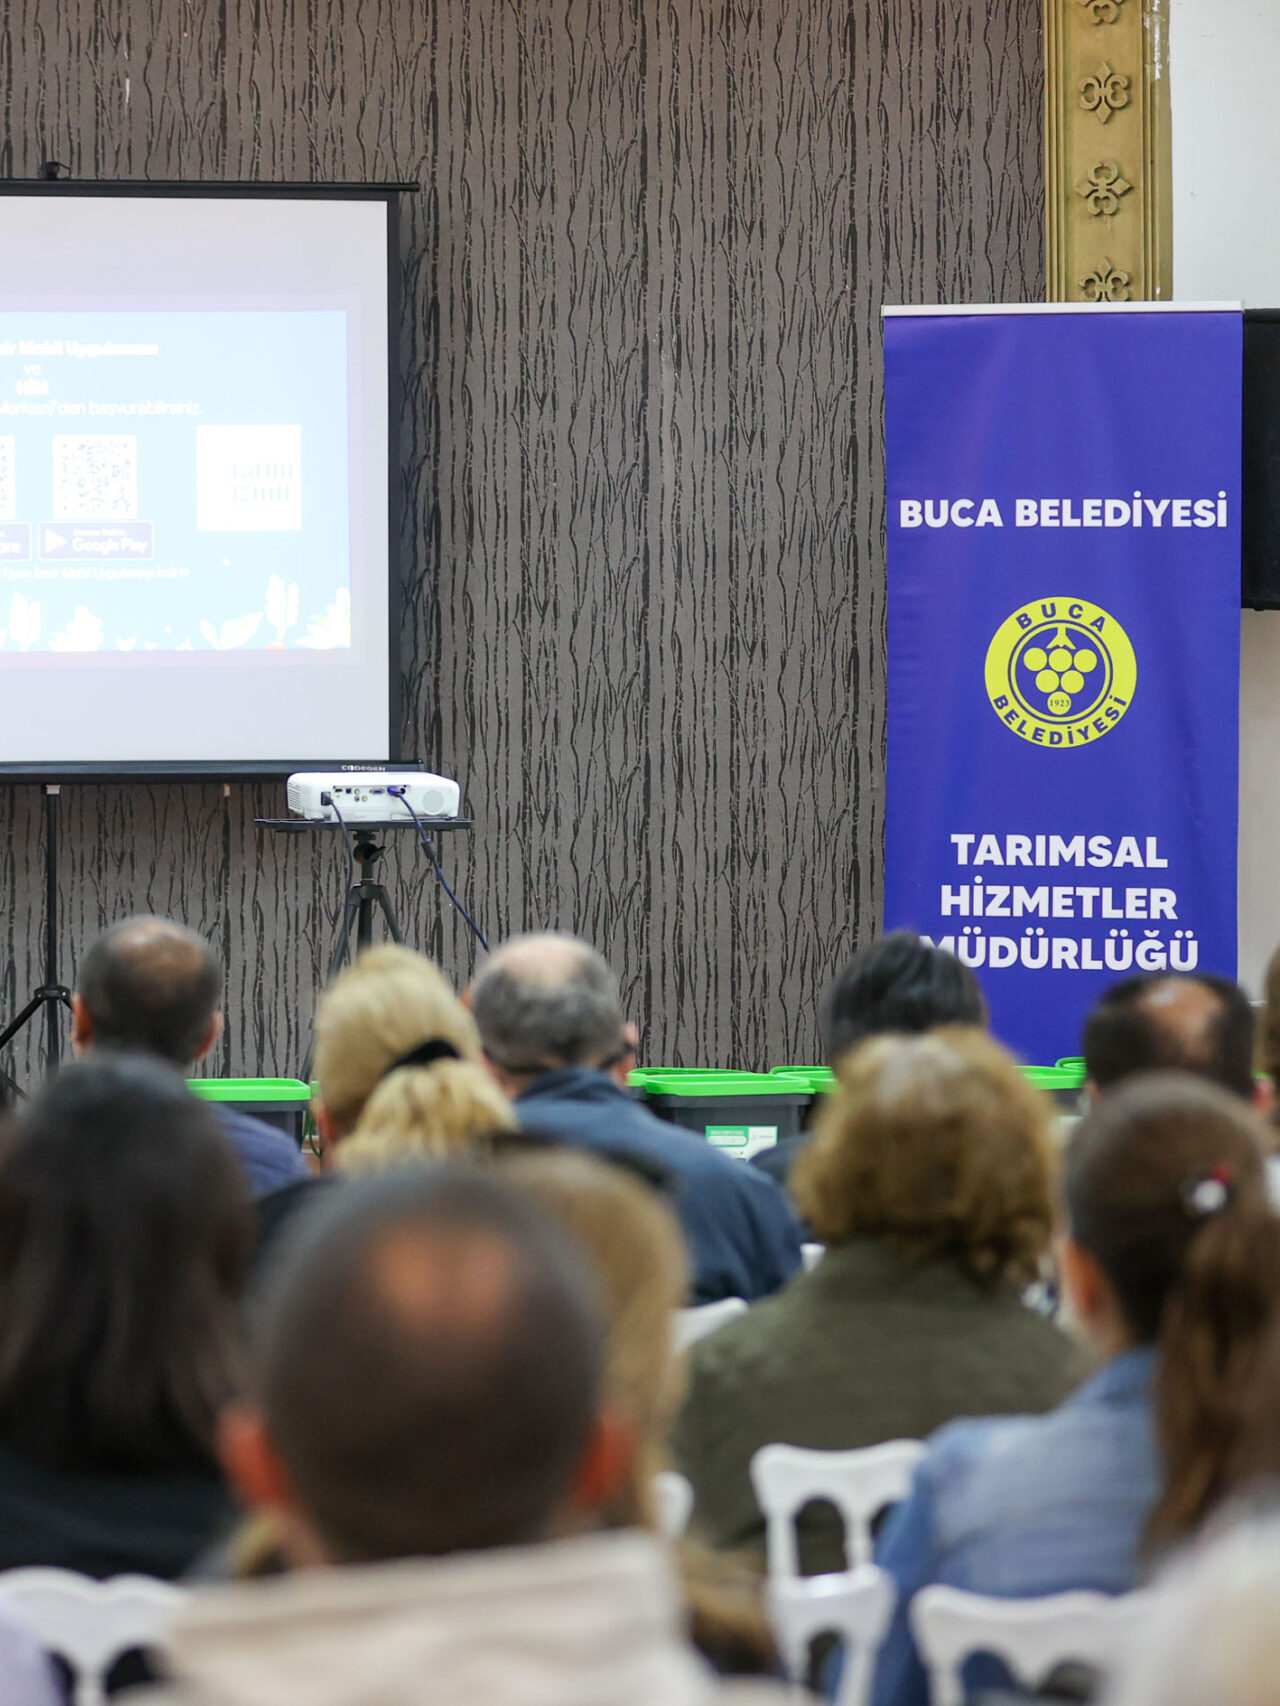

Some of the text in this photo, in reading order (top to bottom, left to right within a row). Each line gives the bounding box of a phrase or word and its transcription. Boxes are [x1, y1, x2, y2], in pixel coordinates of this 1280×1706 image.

[900, 491, 1227, 528] BUCA BELEDİYESİ
[72, 538, 148, 555] Google Play
[1016, 603, 1106, 632] BUCA
[993, 694, 1127, 745] BELEDİYESİ
[1050, 699, 1070, 707] 1923
[950, 834, 1168, 868] TARIMSAL
[941, 876, 1177, 920] HİZMETLER
